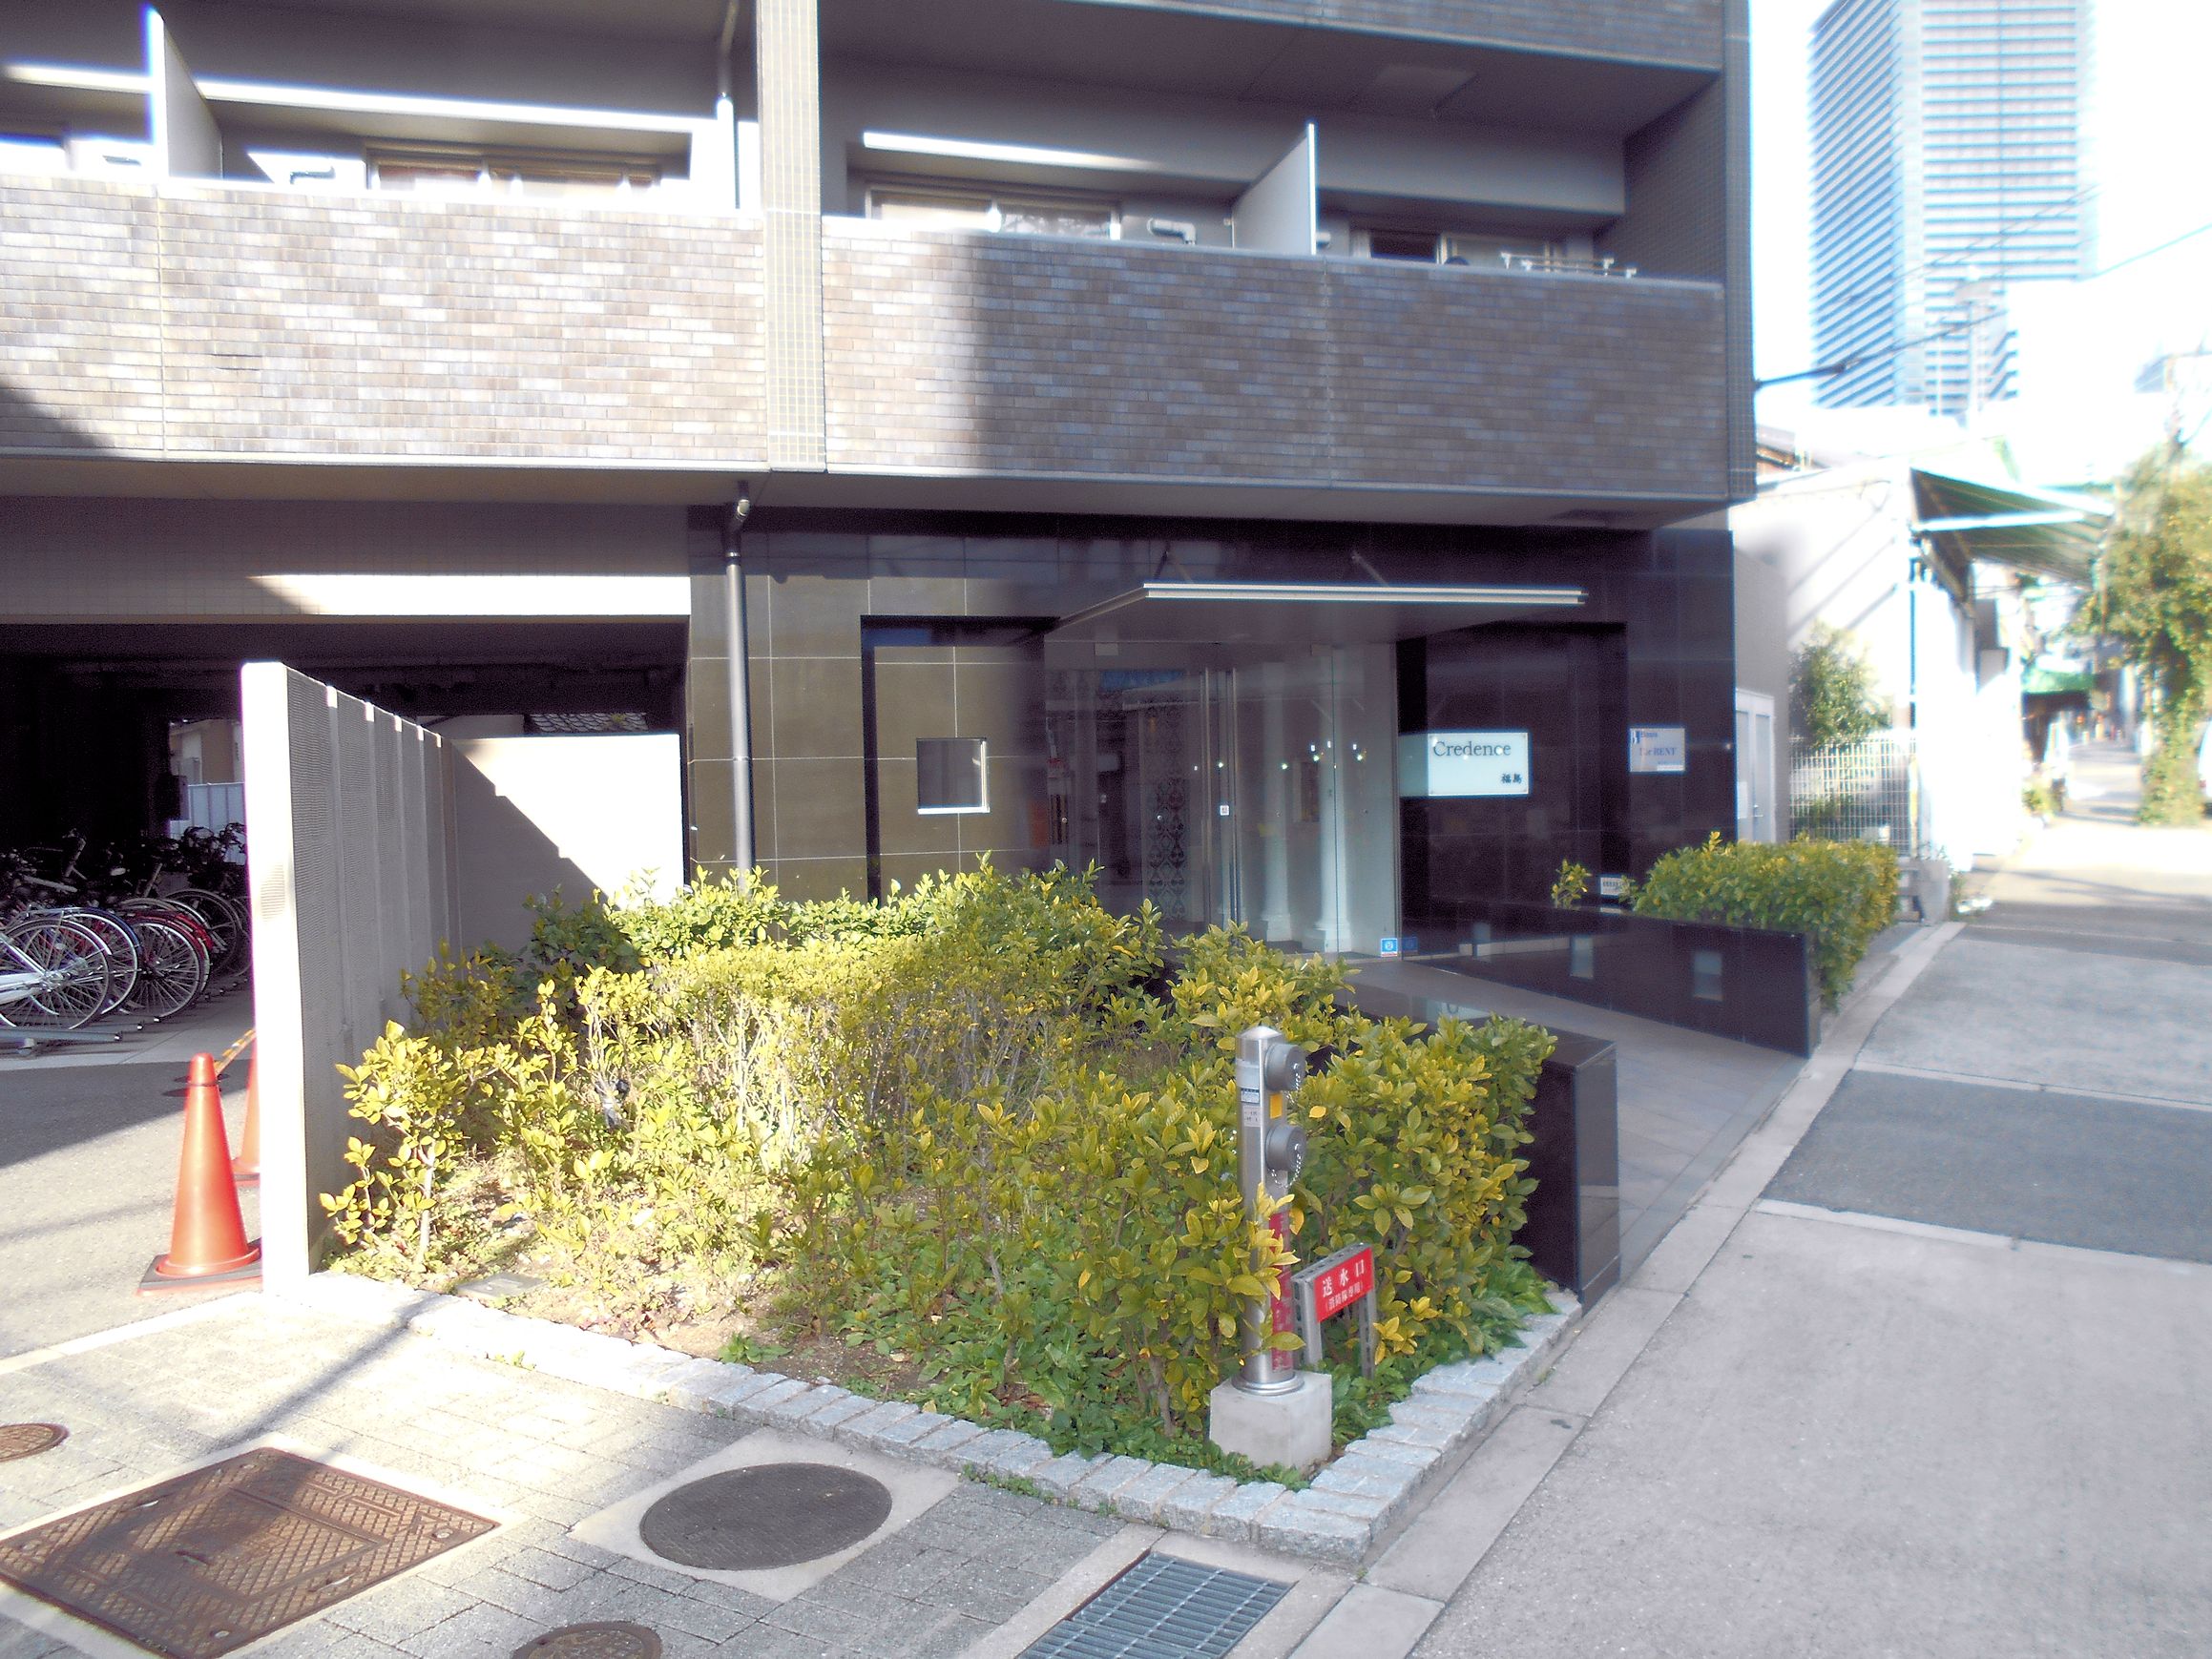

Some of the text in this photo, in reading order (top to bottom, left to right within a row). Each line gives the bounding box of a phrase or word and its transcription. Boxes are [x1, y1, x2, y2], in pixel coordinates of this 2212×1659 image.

[1433, 740, 1512, 757] Credence
[1322, 1258, 1366, 1298] 送水口
